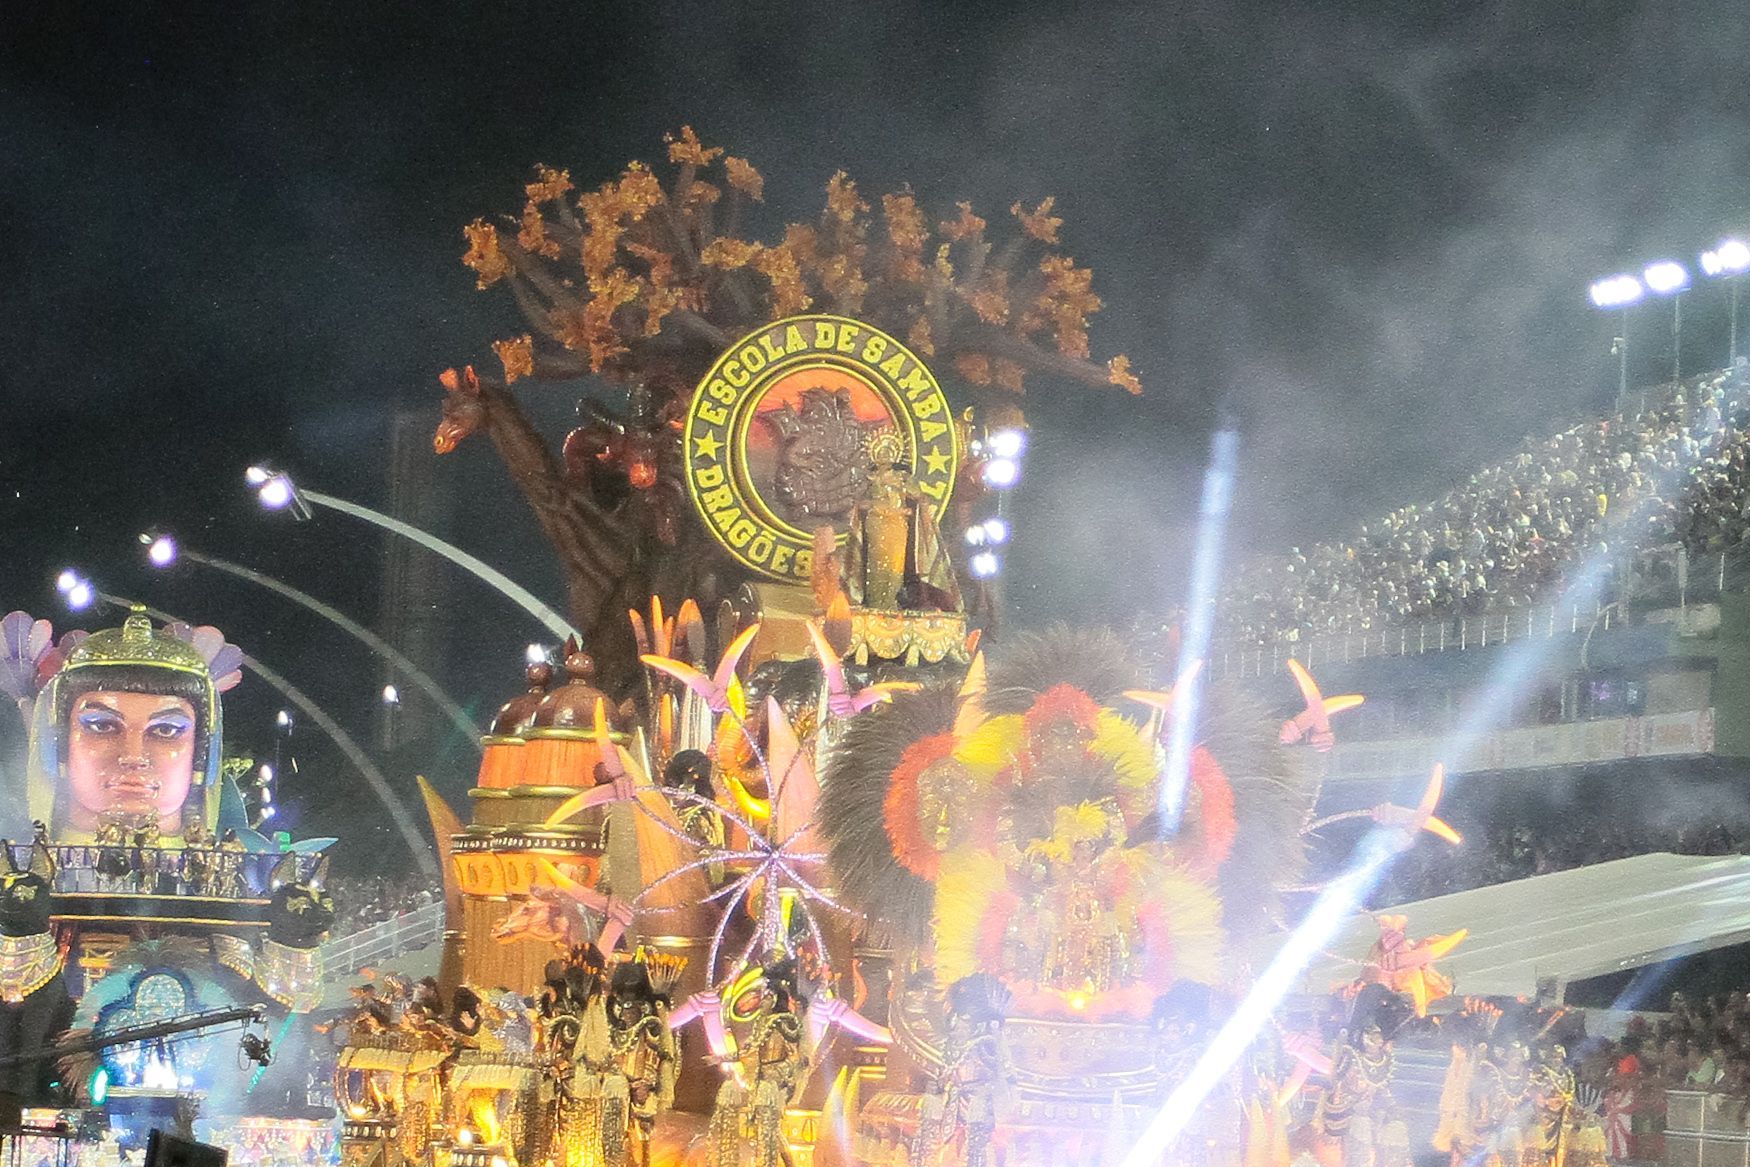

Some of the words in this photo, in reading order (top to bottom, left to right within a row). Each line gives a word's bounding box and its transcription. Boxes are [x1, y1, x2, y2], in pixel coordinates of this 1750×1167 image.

[697, 325, 808, 426] ESCOLA
[815, 322, 859, 352] DE
[862, 336, 947, 442] SAMBA
[696, 465, 813, 576] DRAGÕES
